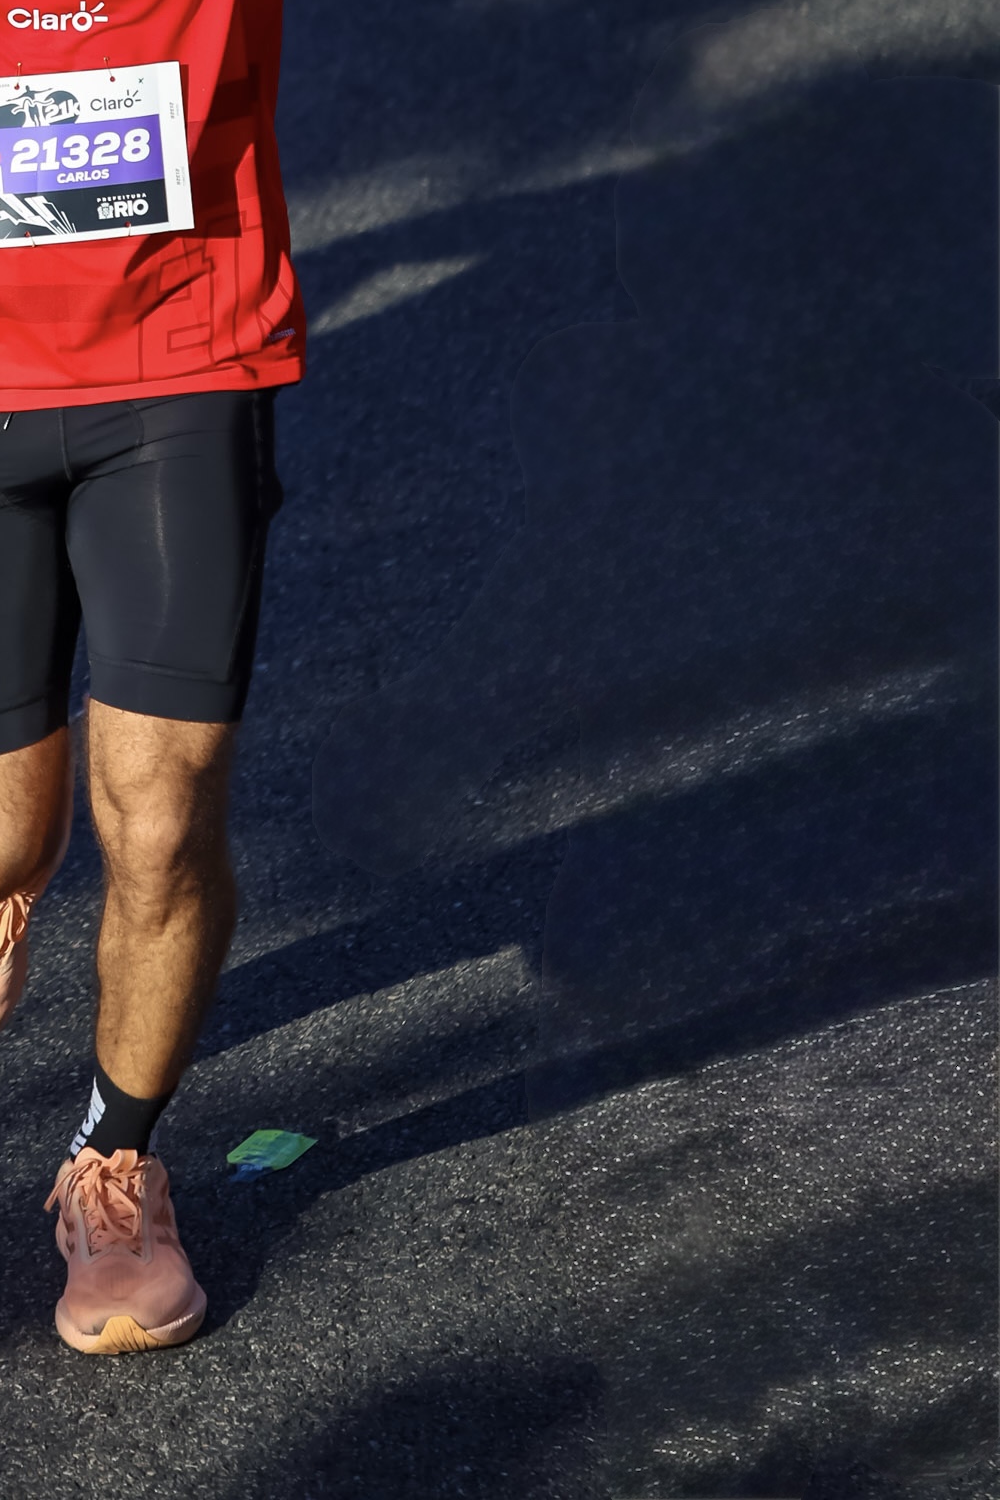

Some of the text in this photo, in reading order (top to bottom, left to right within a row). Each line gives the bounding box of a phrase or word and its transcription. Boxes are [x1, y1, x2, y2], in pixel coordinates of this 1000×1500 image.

[7, 1, 94, 32] Claro
[90, 89, 134, 111] Claro
[10, 128, 151, 173] 21328
[56, 168, 110, 184] CARLOS
[96, 192, 147, 203] PREFEITURA
[113, 198, 149, 218] RIO
